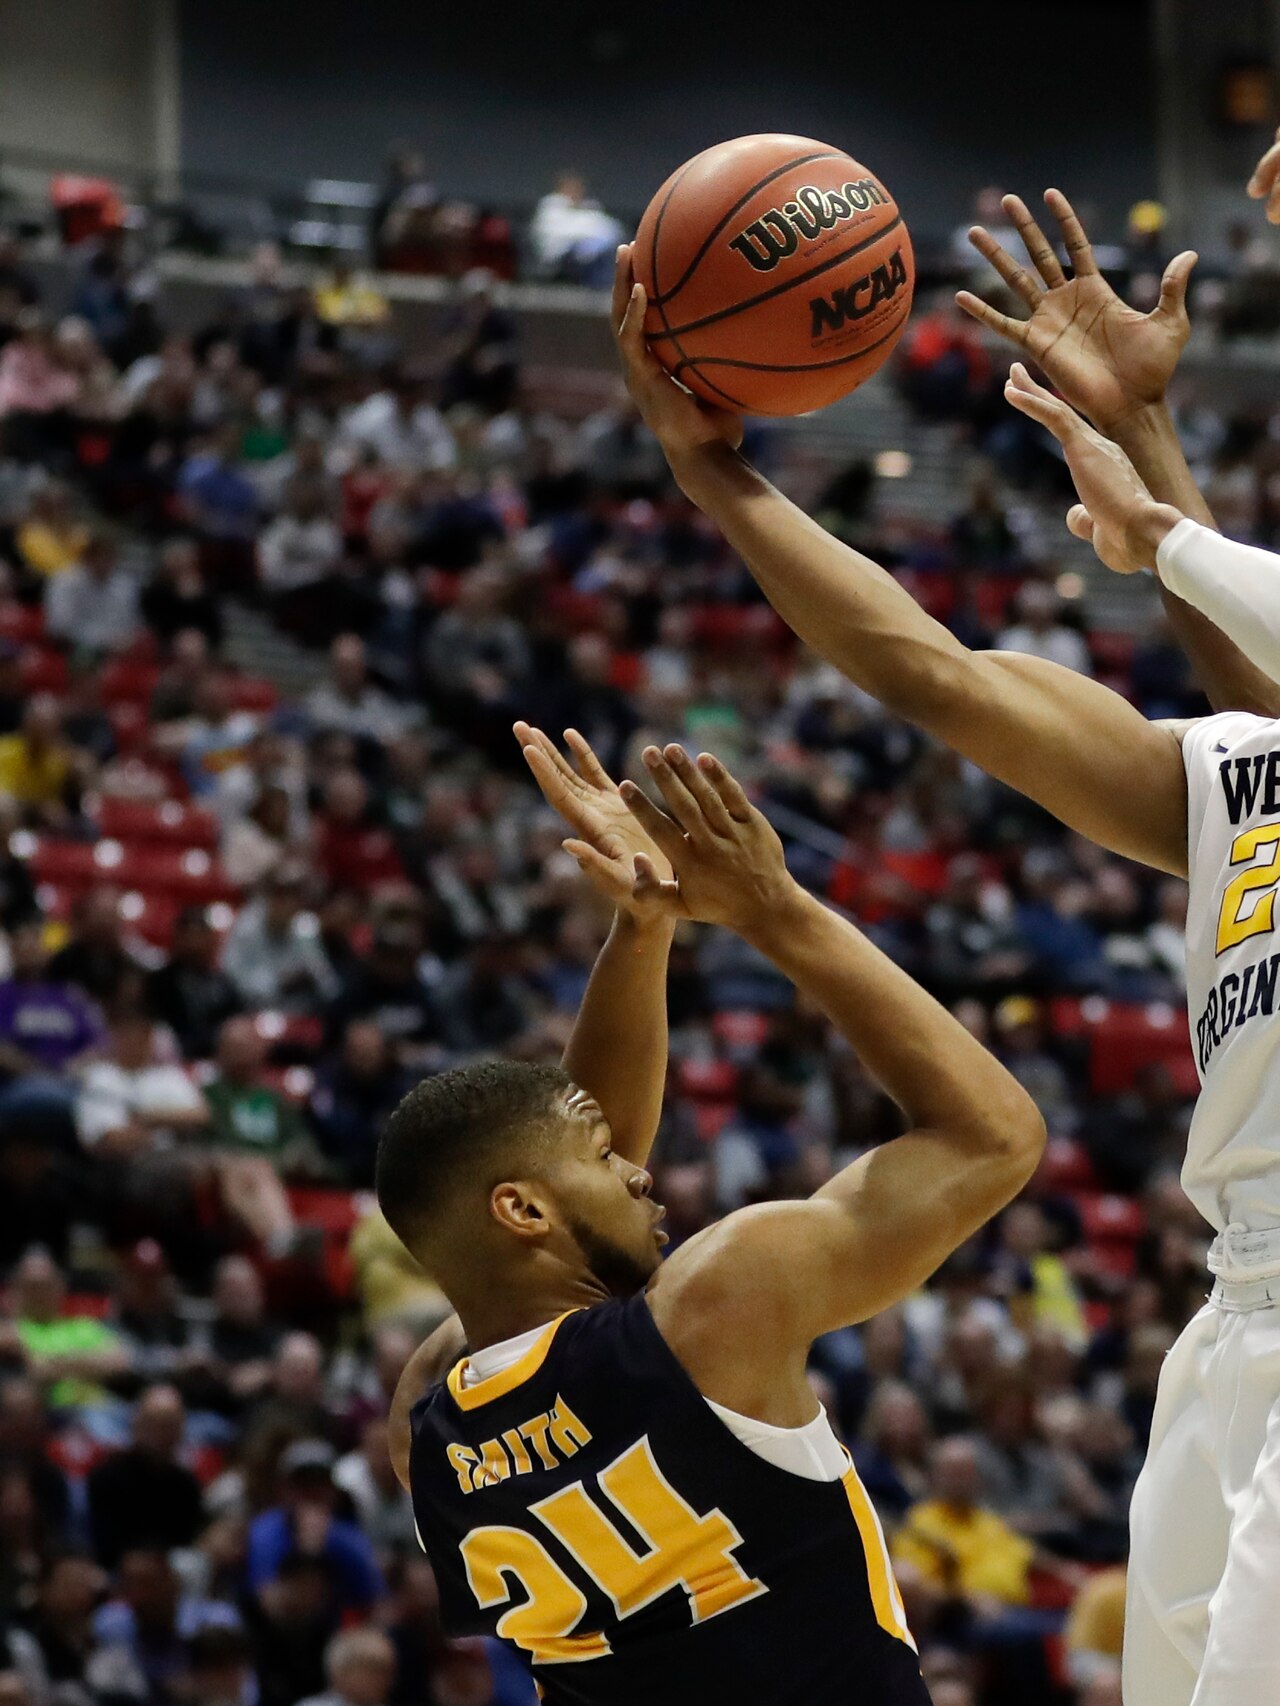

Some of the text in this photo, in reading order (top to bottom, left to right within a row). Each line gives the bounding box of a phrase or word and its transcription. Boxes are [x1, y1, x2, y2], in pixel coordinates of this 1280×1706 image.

[728, 178, 890, 273] Wilson
[809, 247, 907, 338] NCAA
[446, 1391, 593, 1495] SMITH
[458, 1433, 771, 1665] 24
